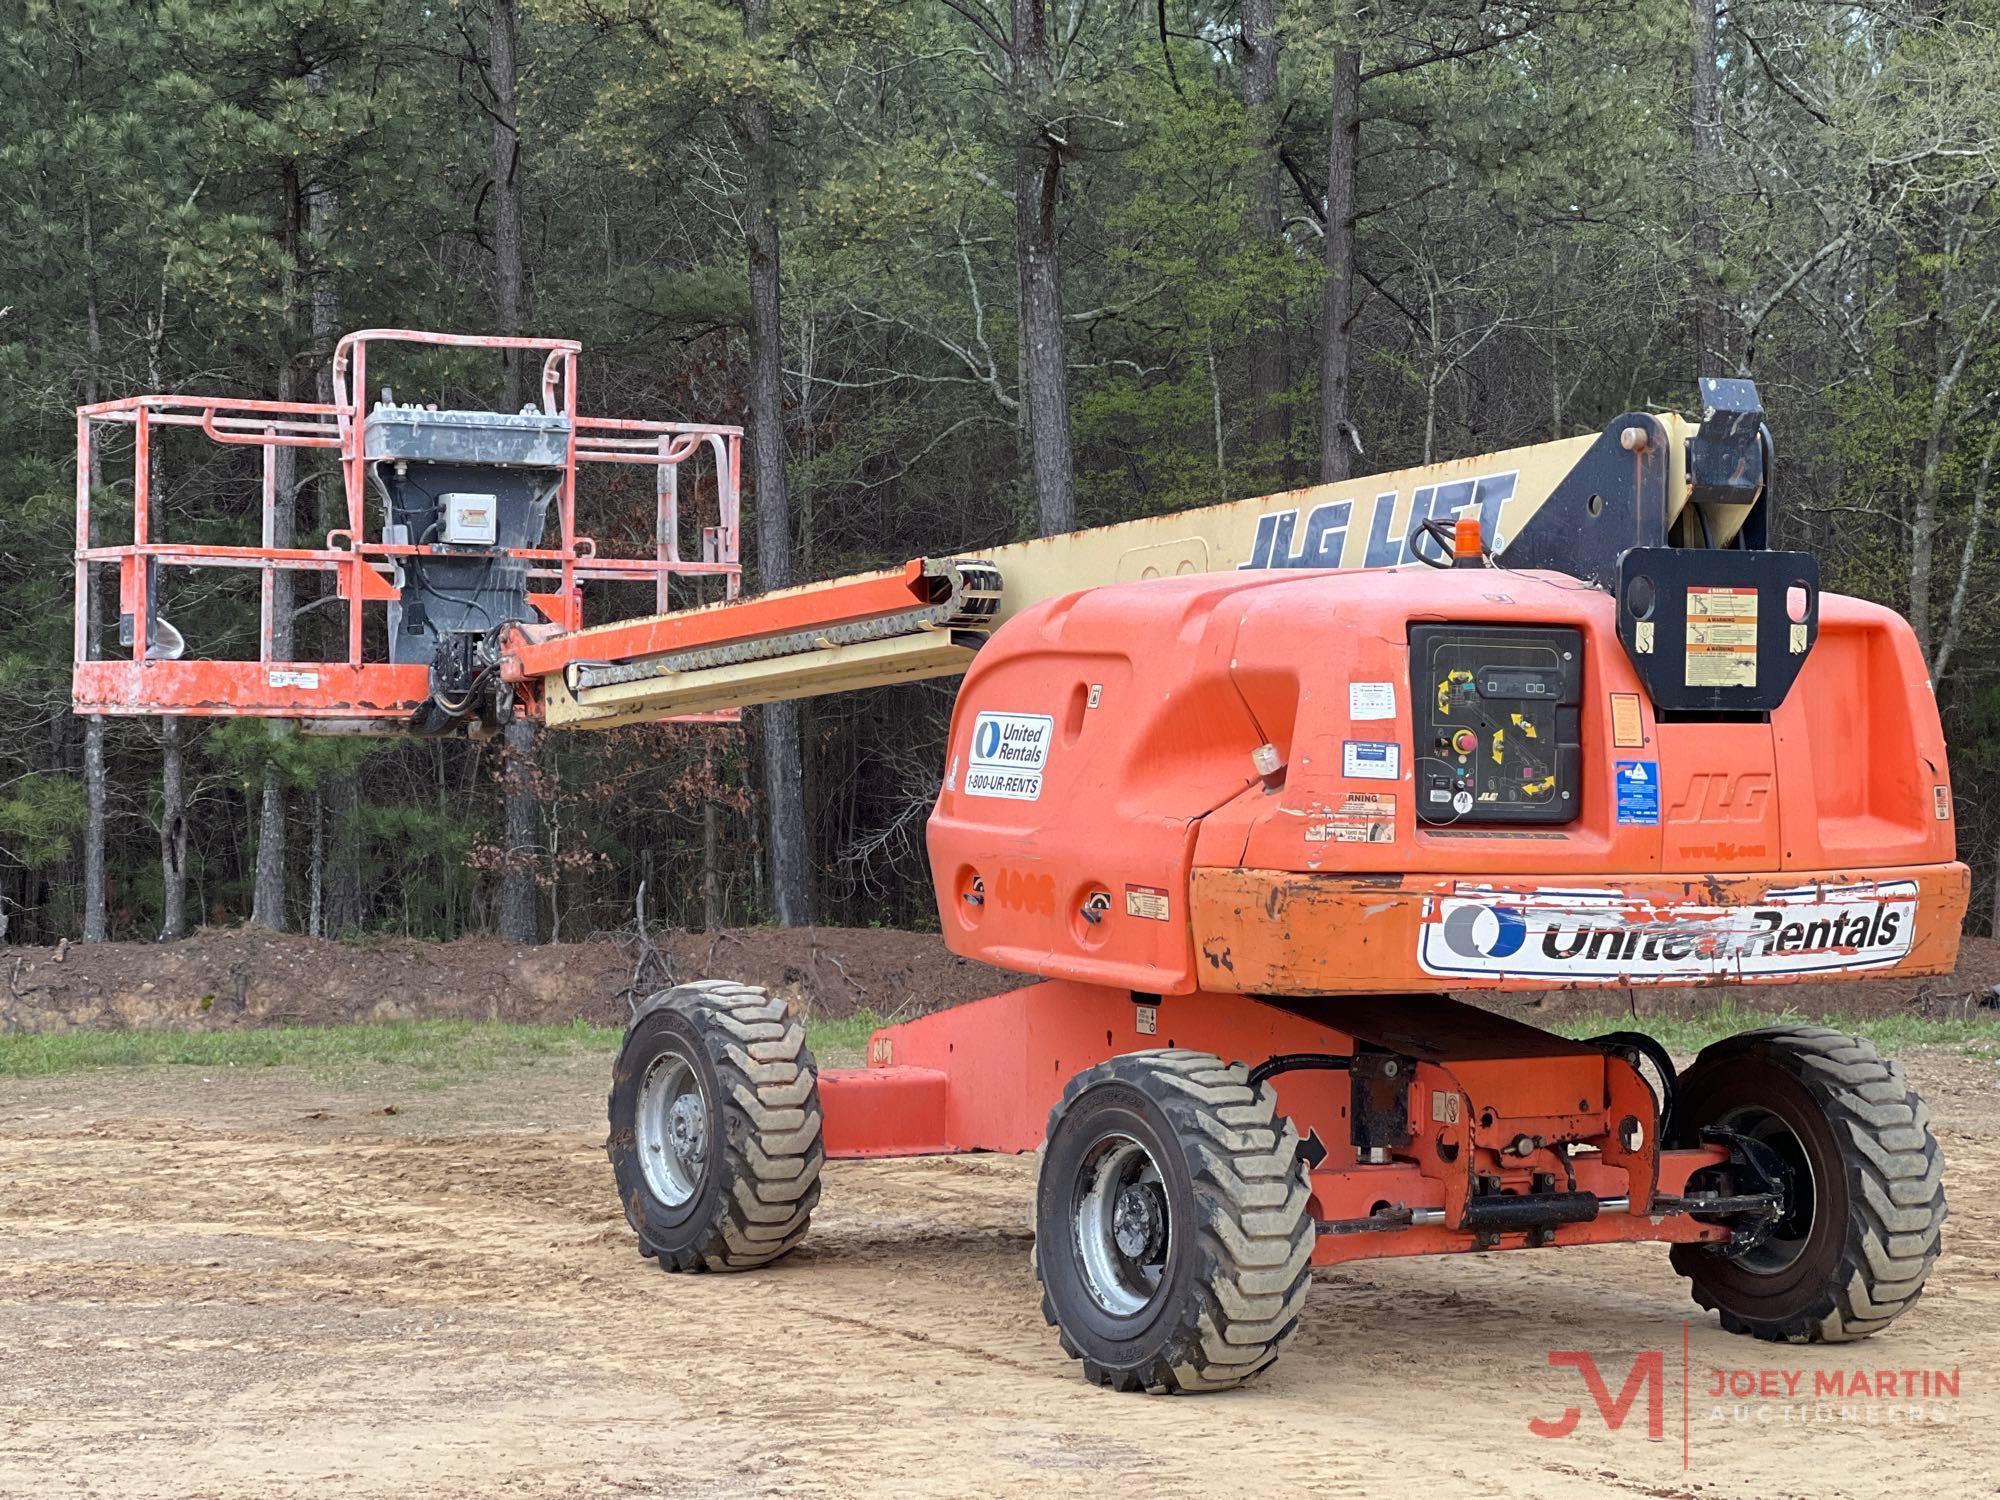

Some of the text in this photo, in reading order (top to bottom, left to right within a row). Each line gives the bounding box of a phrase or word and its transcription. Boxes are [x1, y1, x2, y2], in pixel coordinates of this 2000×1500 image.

[1237, 469, 1520, 570] JLG LIFT
[1003, 723, 1044, 743] United
[998, 743, 1042, 762] Rentals
[967, 774, 1039, 794] 1-800-UR-RENTS
[1478, 792, 1499, 801] JLG
[1667, 773, 1772, 824] JLG
[1740, 903, 1901, 958] Rentals
